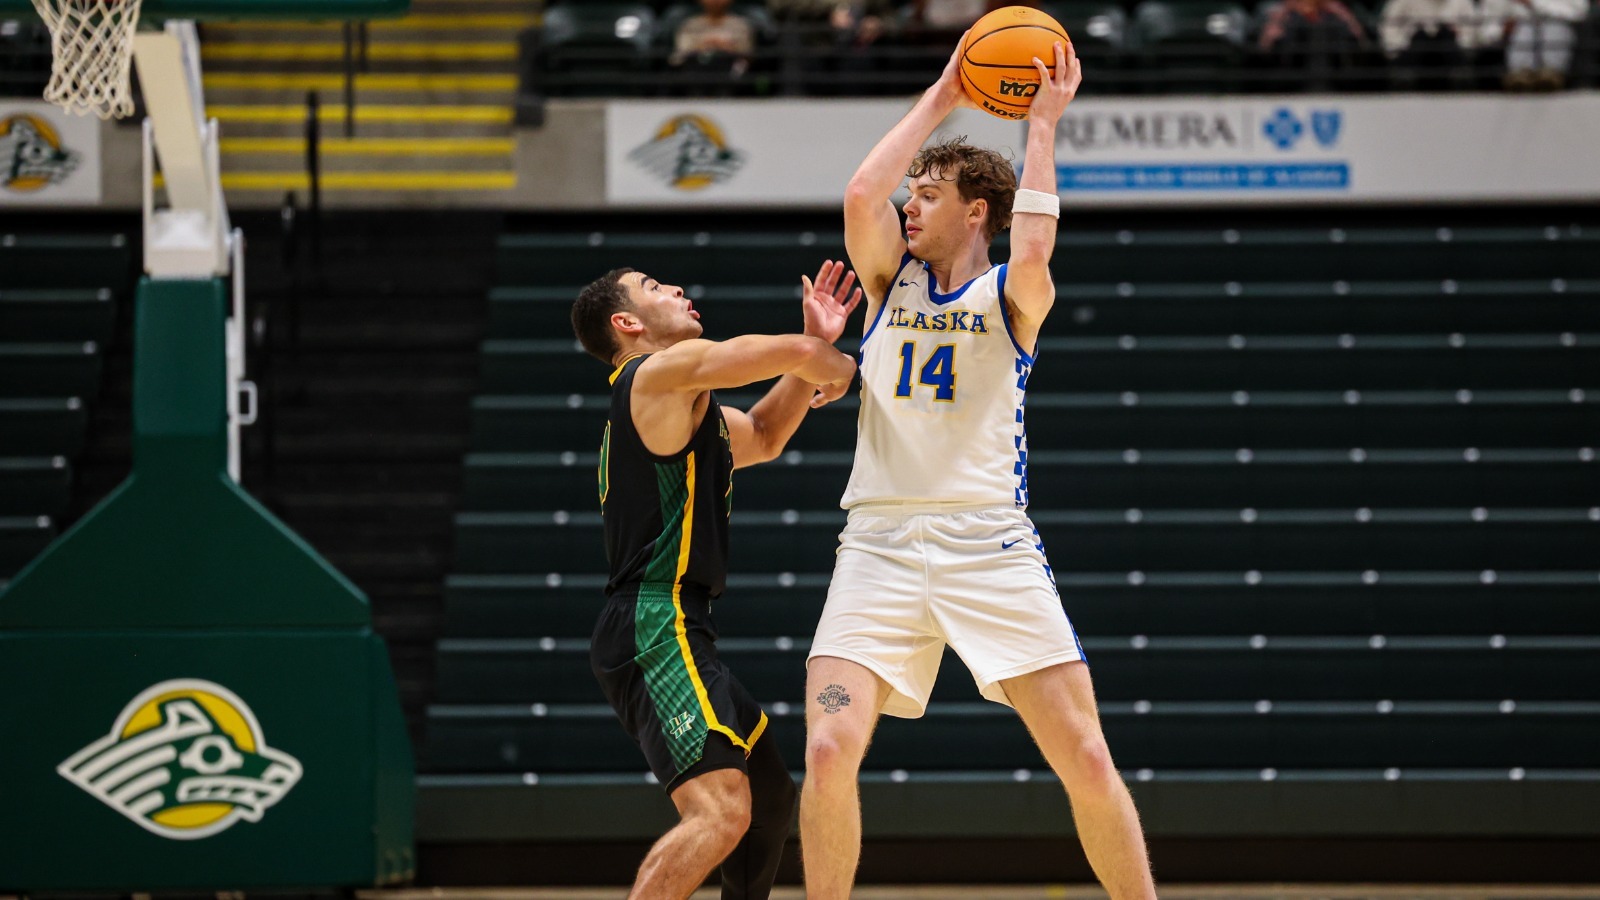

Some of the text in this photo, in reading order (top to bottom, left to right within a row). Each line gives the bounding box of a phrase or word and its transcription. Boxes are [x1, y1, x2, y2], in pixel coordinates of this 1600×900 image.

[999, 80, 1040, 98] CAA
[1022, 110, 1236, 148] REMERA
[894, 340, 957, 402] 14
